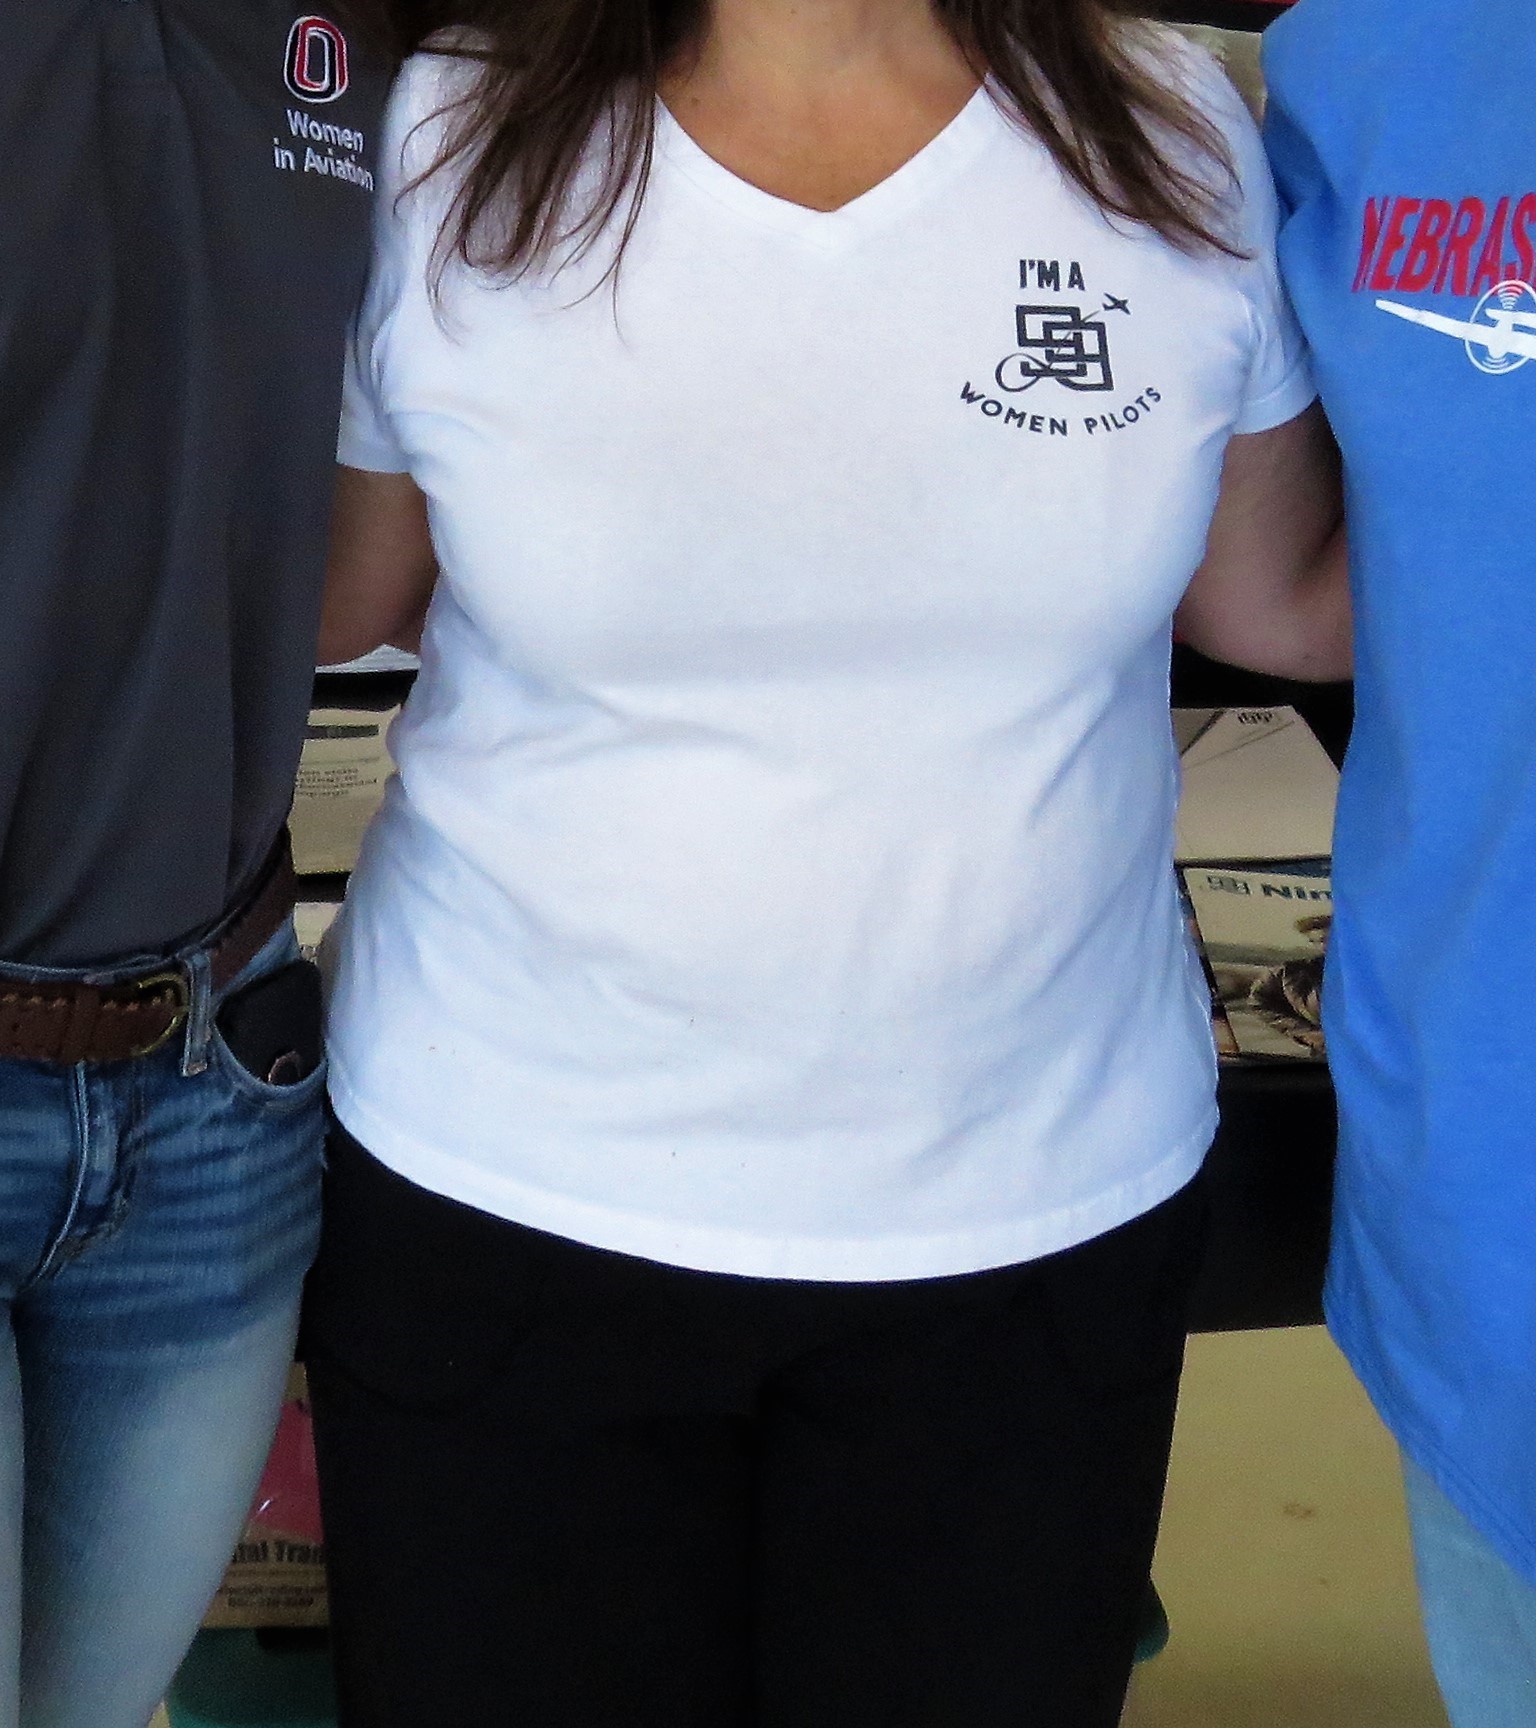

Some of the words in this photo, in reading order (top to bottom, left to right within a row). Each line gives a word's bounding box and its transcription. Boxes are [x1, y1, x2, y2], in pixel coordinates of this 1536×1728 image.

[285, 108, 364, 154] Women
[273, 137, 296, 170] in
[304, 147, 375, 191] Aviation
[1019, 258, 1061, 292] I'M
[1067, 260, 1086, 291] A
[959, 381, 1068, 437] WOMEN
[1083, 386, 1162, 435] PILOTS
